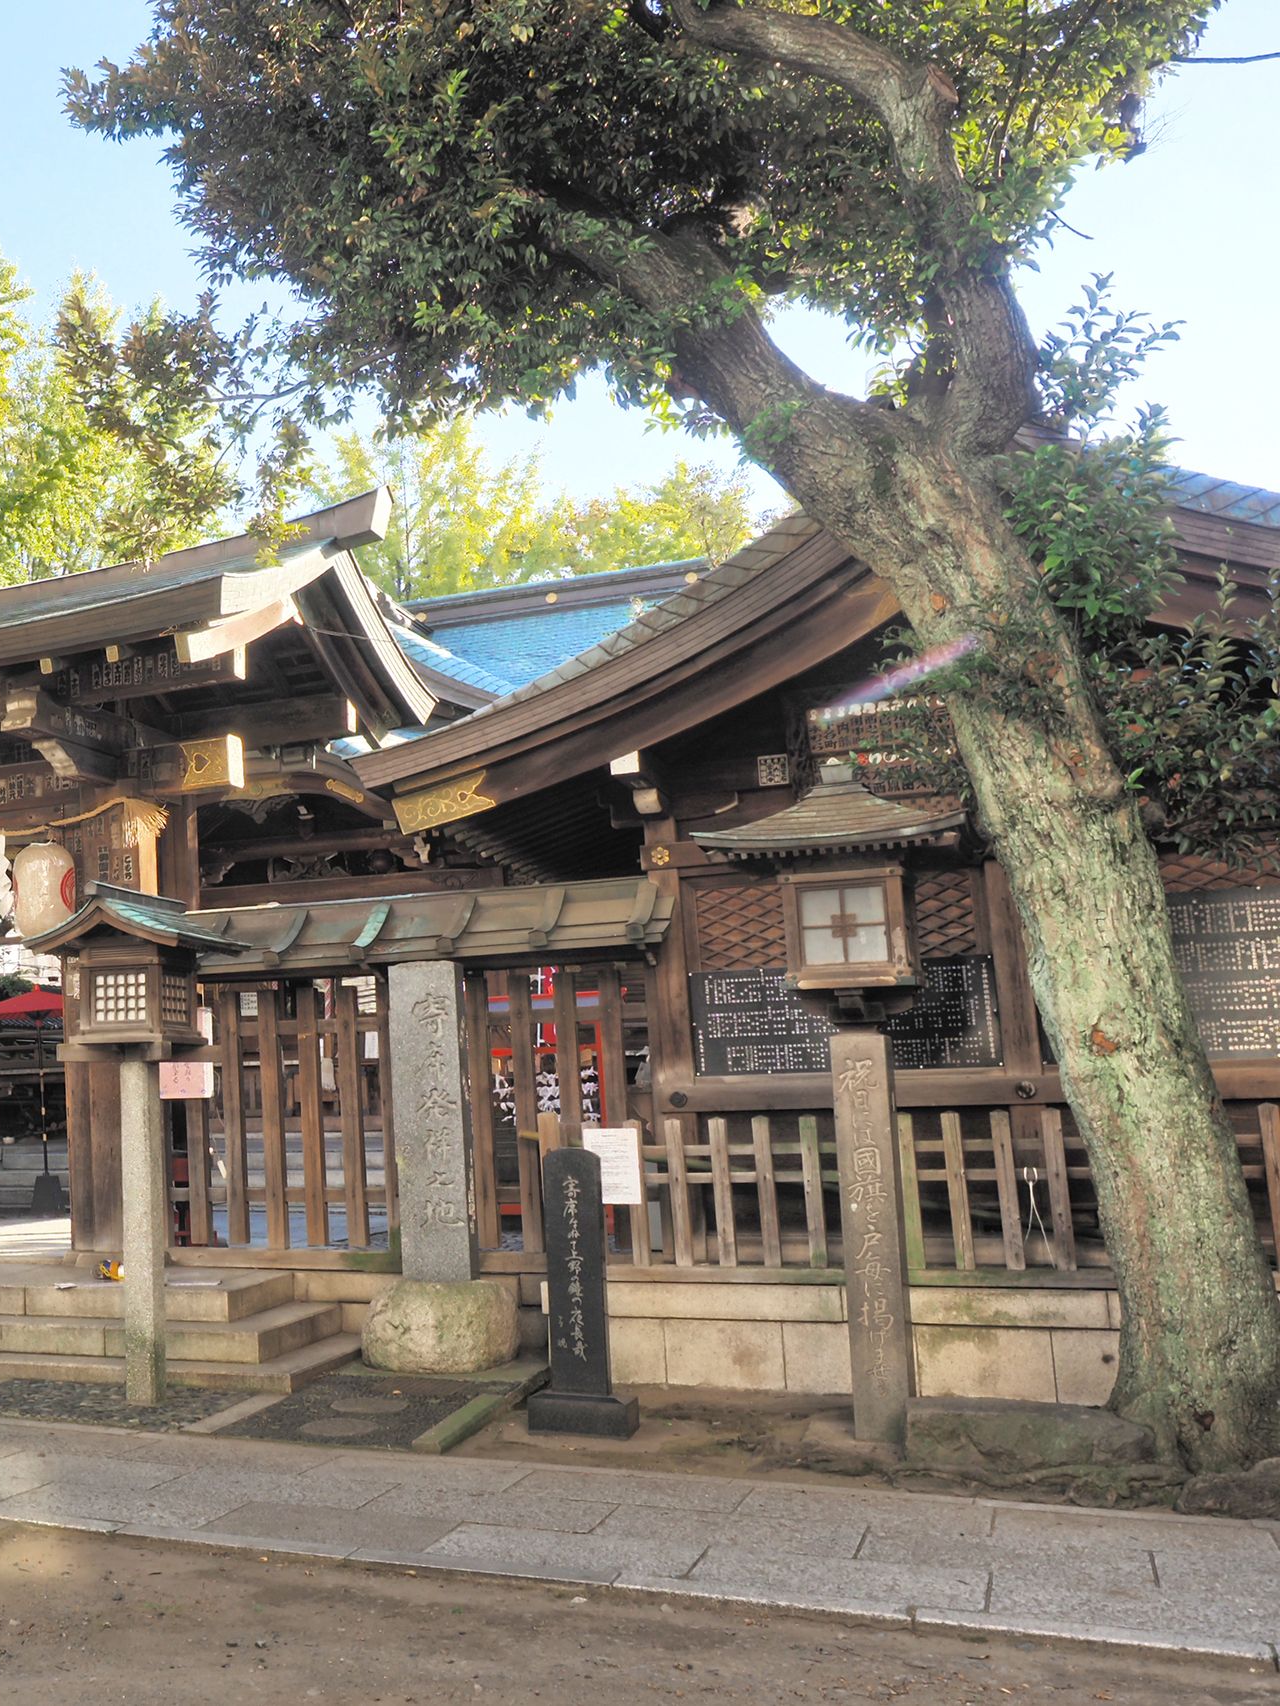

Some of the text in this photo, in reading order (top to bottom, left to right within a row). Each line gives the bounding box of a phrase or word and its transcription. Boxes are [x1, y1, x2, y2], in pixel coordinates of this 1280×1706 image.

[411, 993, 465, 1229] 寄席発祥之地
